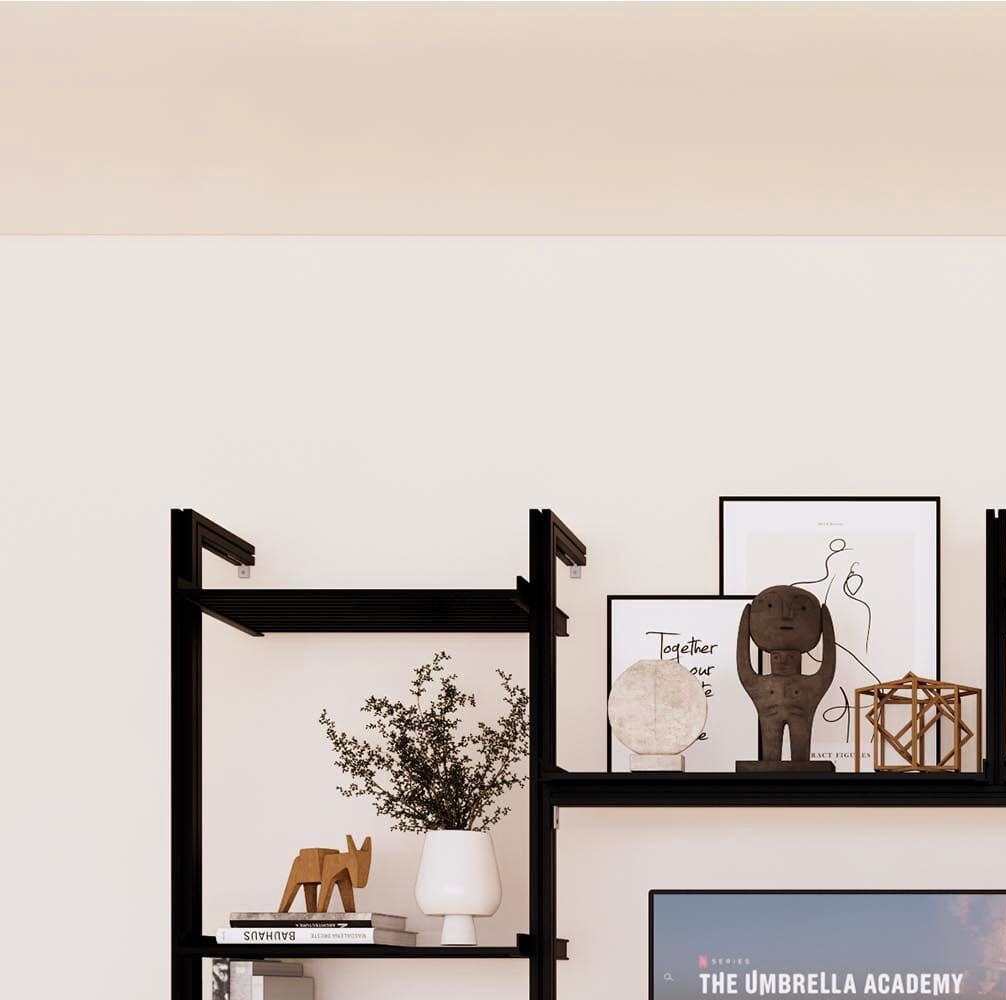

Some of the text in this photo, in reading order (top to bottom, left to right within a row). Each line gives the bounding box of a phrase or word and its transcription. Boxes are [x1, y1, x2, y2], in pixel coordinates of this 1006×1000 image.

[646, 631, 719, 664] Together
[243, 930, 296, 941] BAUHAUS
[698, 970, 963, 996] THE UMBRELLA ACADEMY
